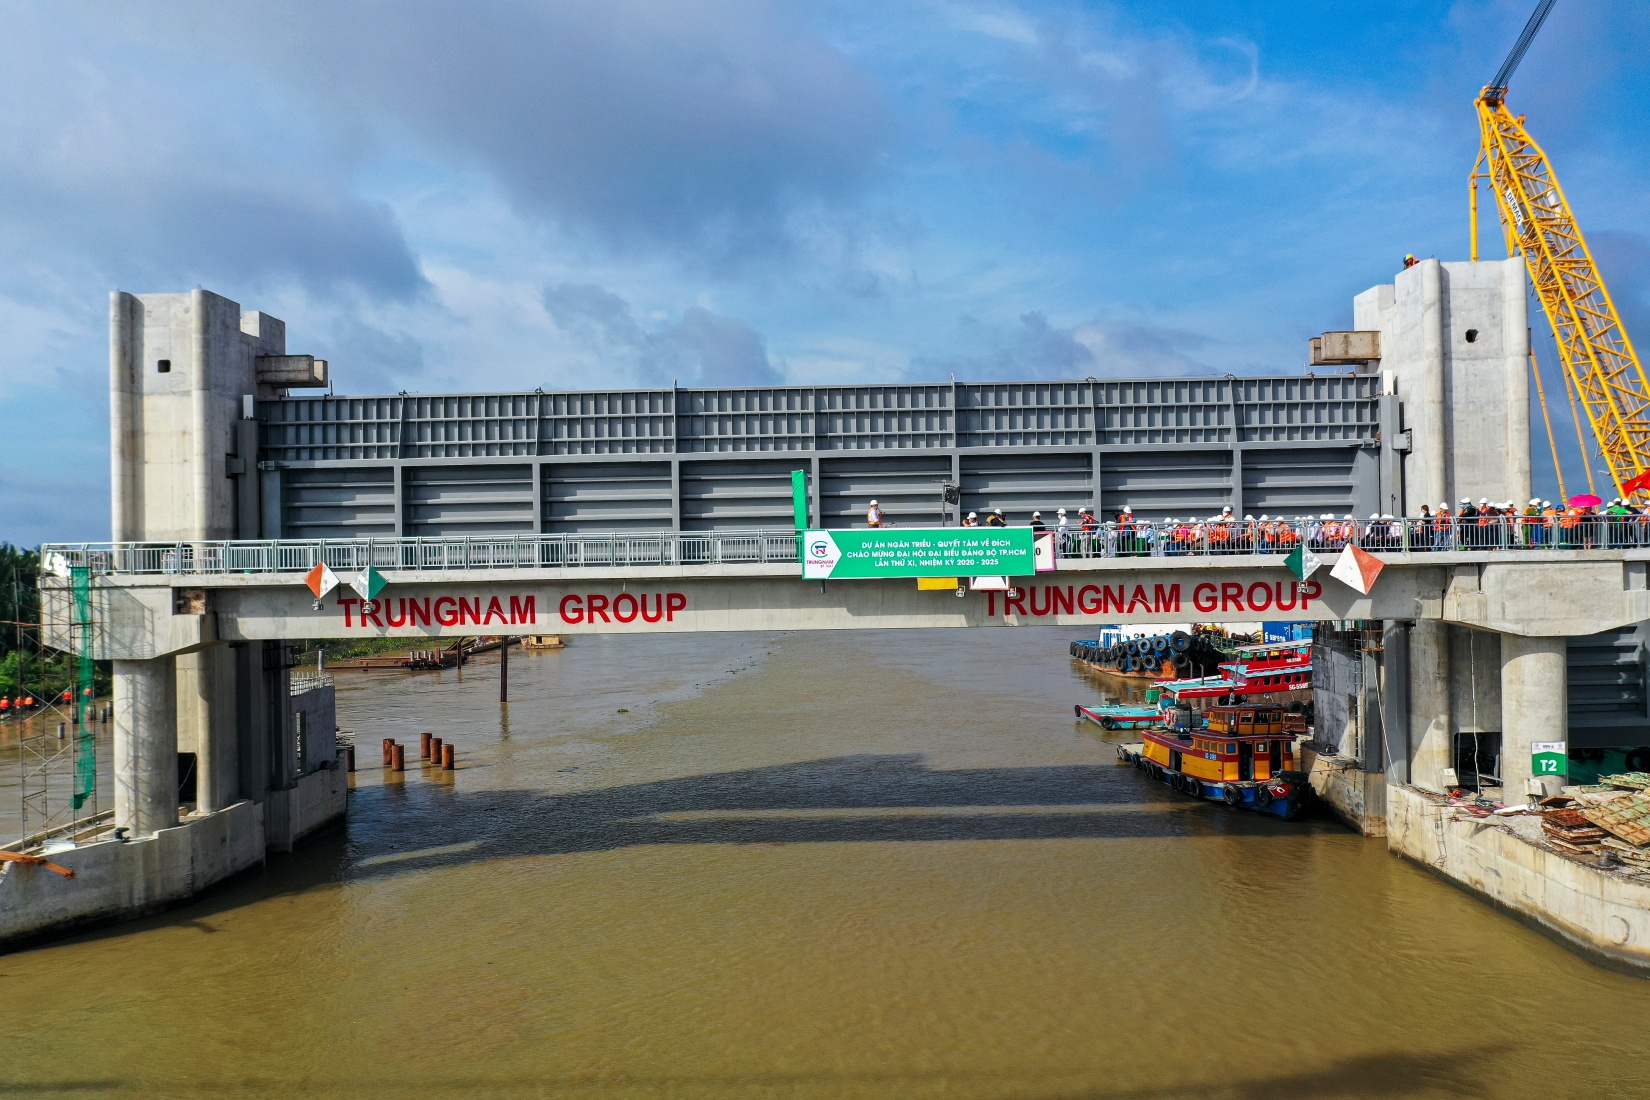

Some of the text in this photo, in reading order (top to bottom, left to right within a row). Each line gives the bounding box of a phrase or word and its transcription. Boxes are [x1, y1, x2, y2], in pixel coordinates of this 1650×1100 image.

[1506, 192, 1522, 222] DEMAG
[862, 542, 872, 550] DỰ
[874, 540, 885, 548] ÁN
[920, 558, 942, 567] NHIỆM
[980, 581, 1322, 617] TRUNGNAM GROUP
[337, 592, 687, 628] TRUNGNAM GROUP
[1540, 760, 1557, 771] T2
